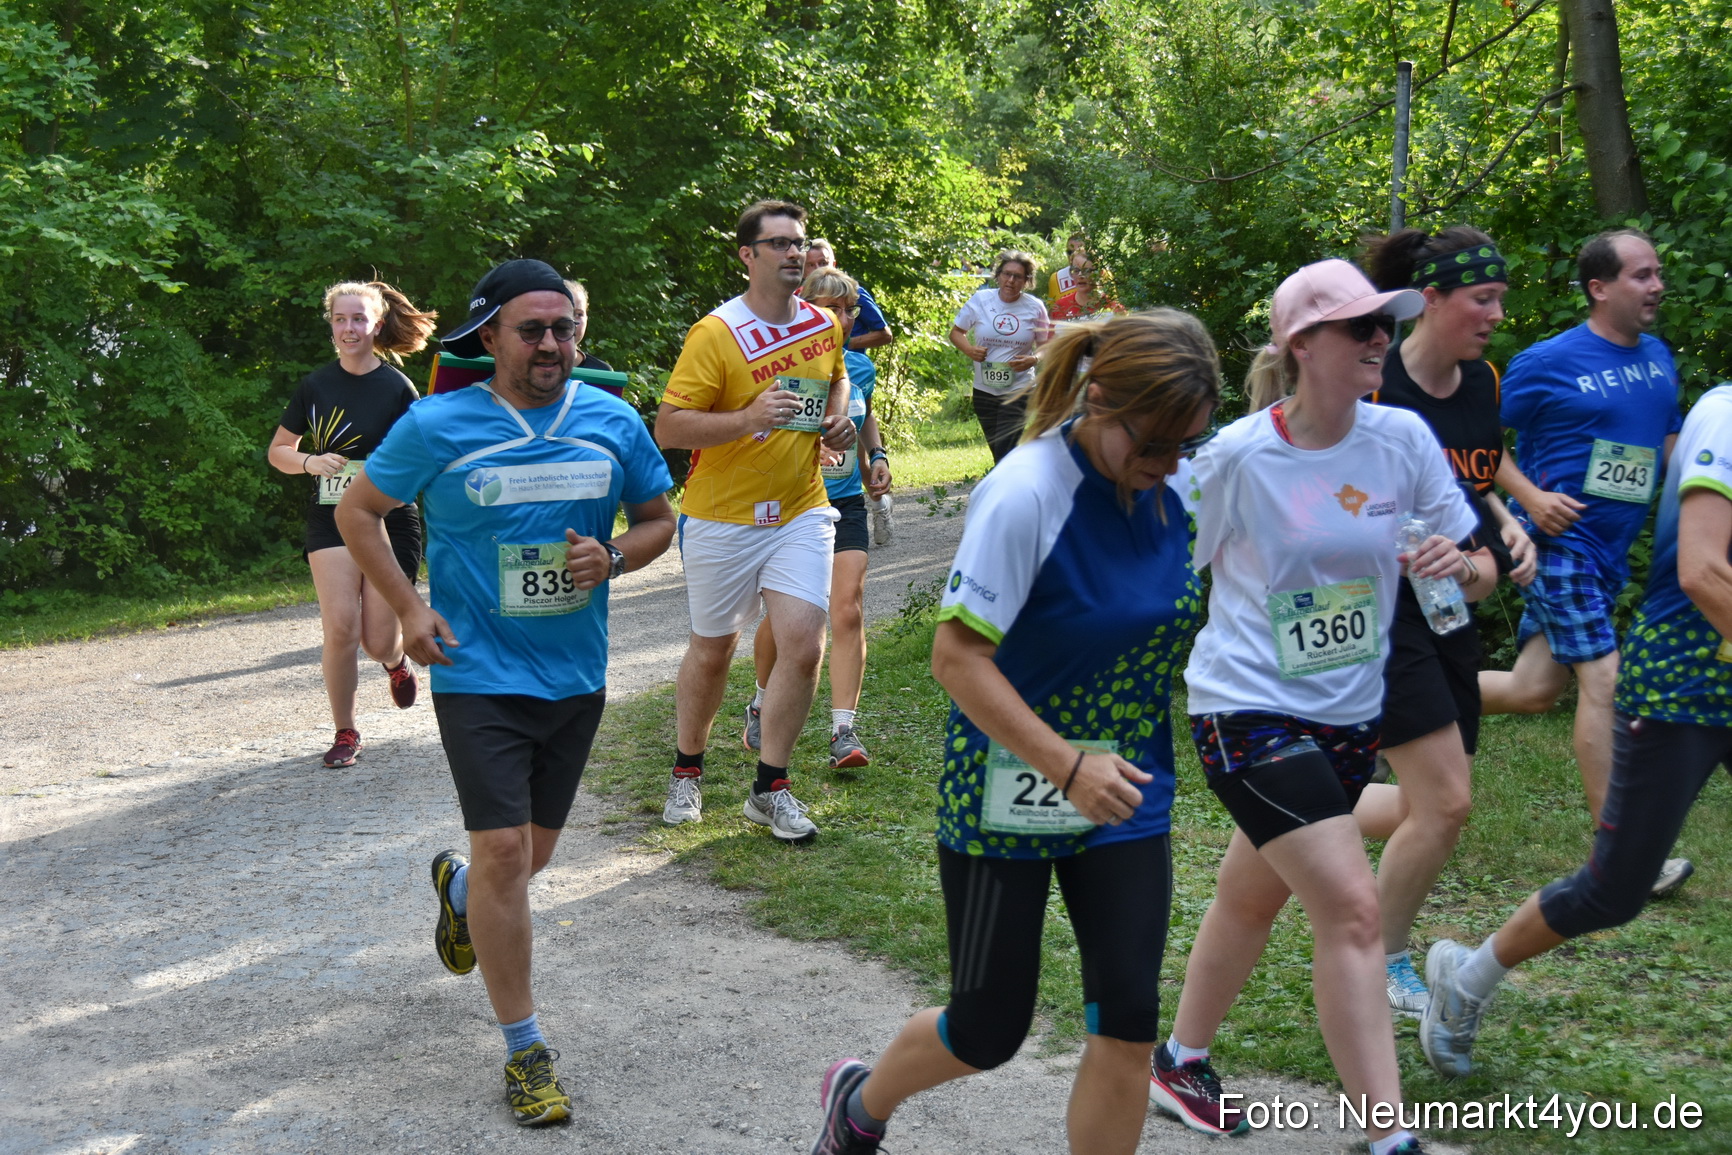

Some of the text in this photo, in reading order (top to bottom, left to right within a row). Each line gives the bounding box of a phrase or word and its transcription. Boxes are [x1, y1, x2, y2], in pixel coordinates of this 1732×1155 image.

[751, 336, 837, 384] MAX BÖGL
[984, 371, 1010, 381] 1895
[528, 474, 569, 483] katholische
[570, 472, 608, 480] Volksschule
[1596, 461, 1648, 487] 2043
[1366, 508, 1396, 517] NEUMARKT
[522, 568, 576, 597] 839
[554, 594, 577, 603] Holger
[1289, 610, 1365, 651] 1360
[1307, 644, 1356, 660] Rückert Julia
[1012, 772, 1069, 807] 22
